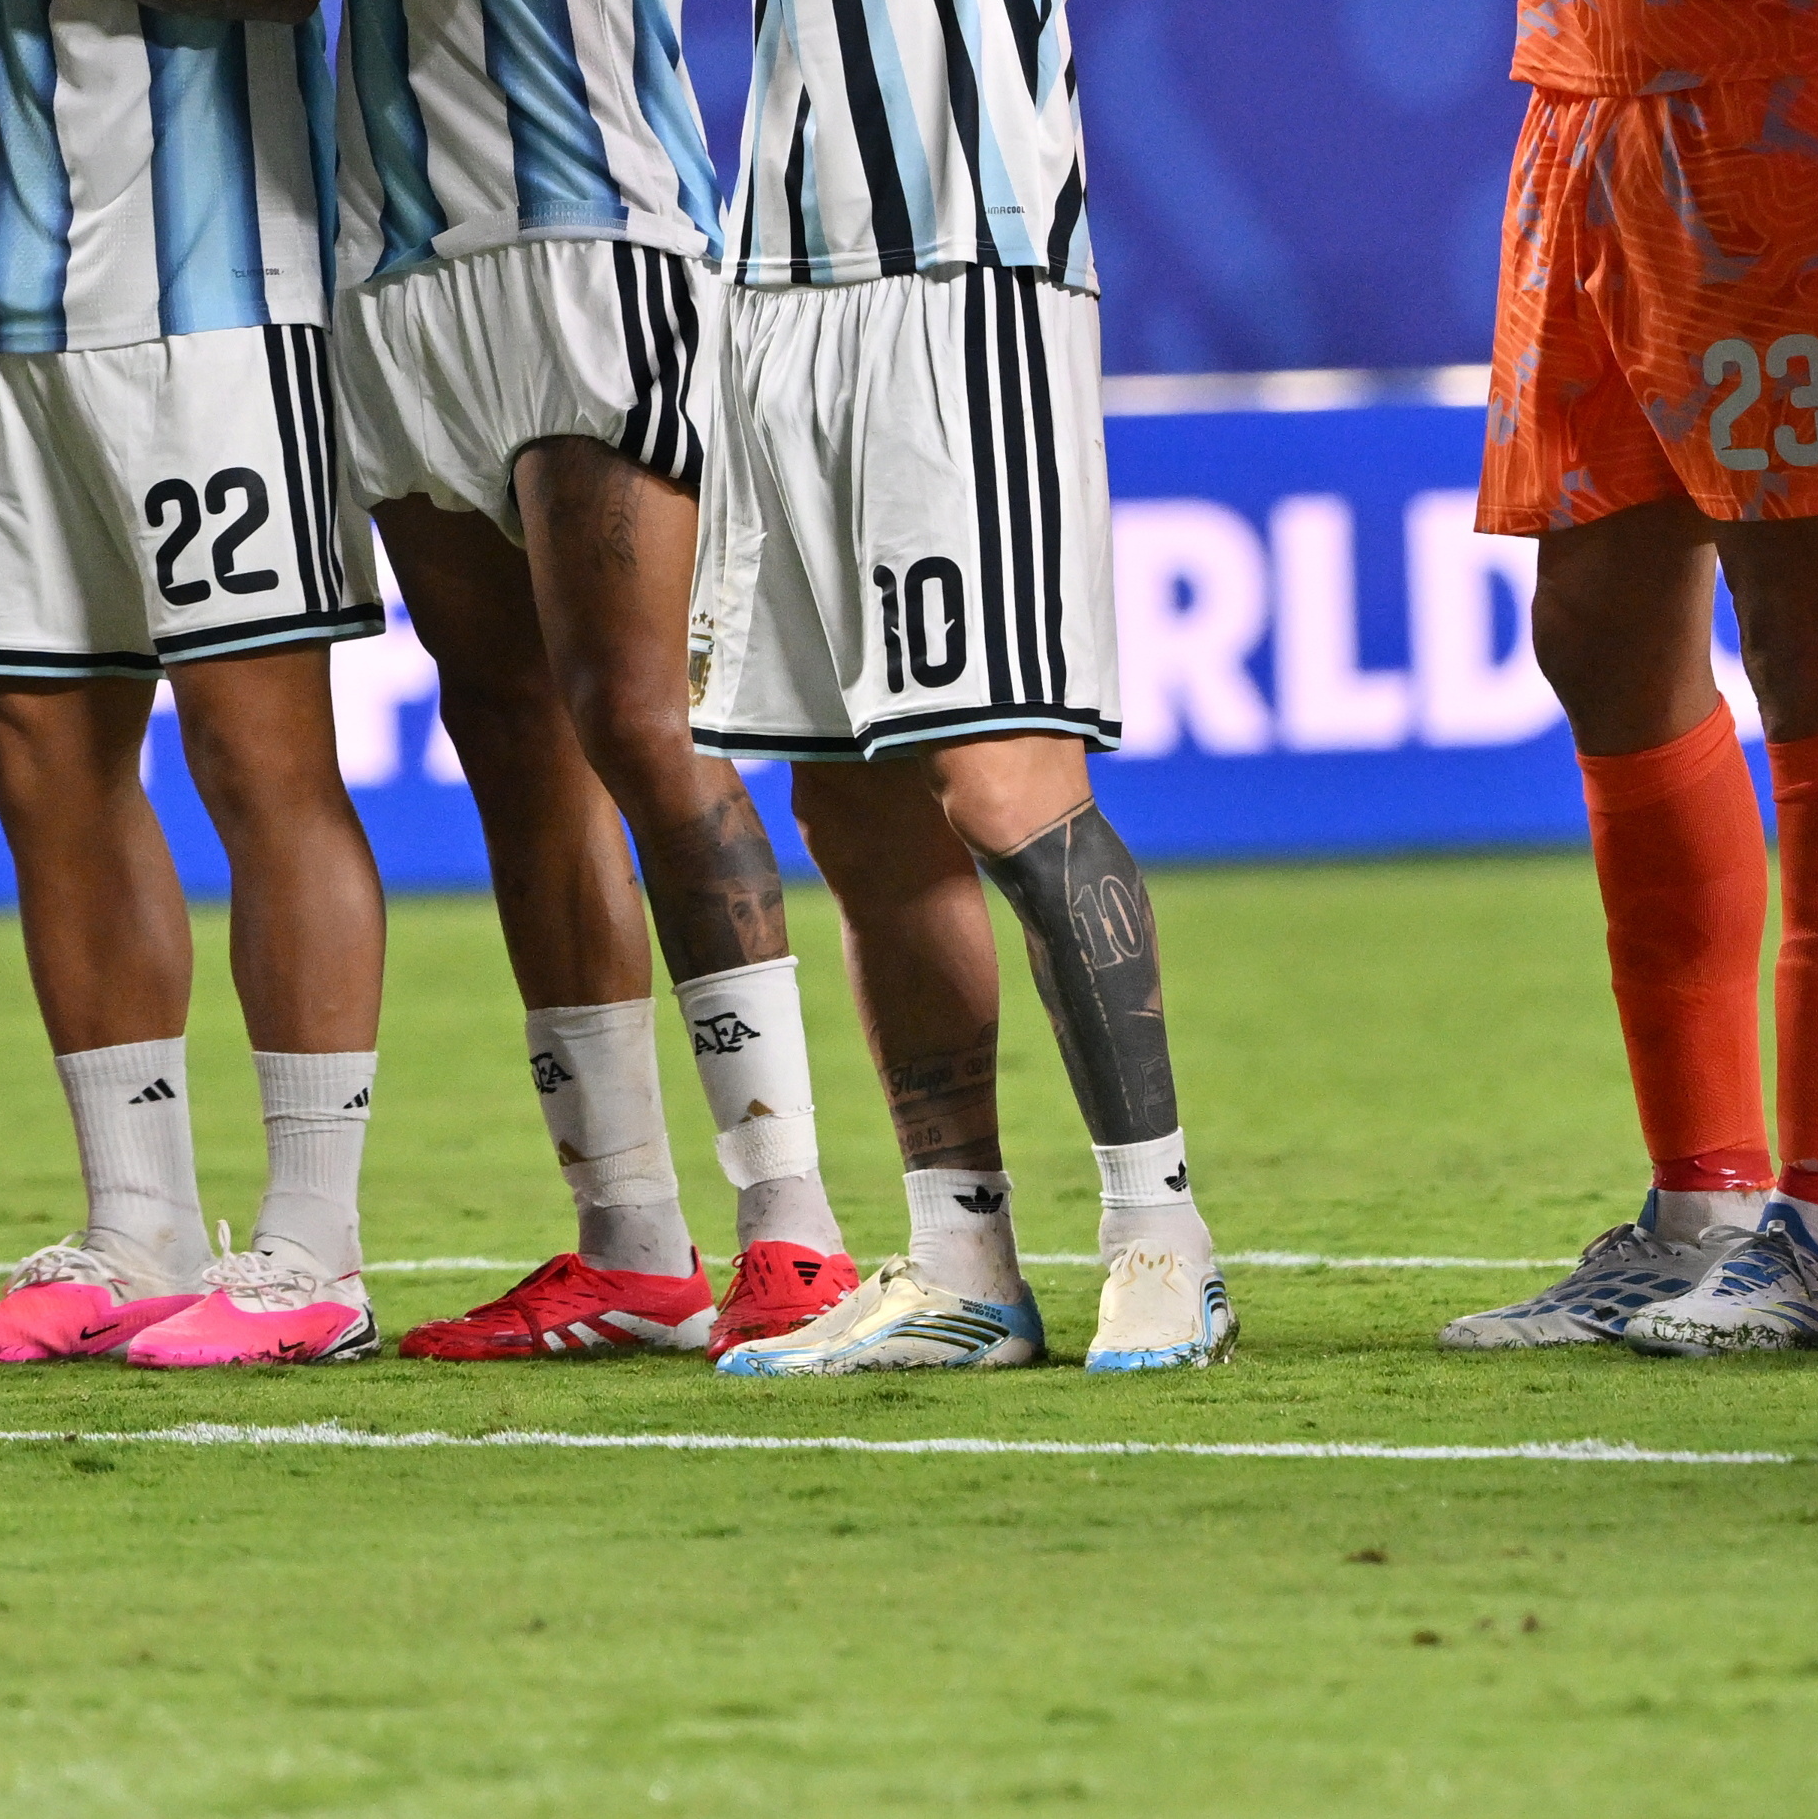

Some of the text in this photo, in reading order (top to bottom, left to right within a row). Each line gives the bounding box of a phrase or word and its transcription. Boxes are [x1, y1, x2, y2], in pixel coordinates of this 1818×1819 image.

[145, 466, 279, 607] 22
[873, 556, 966, 693] 10
[1072, 874, 1144, 971] 10
[530, 1051, 574, 1095] FA
[694, 1011, 761, 1056] AFA
